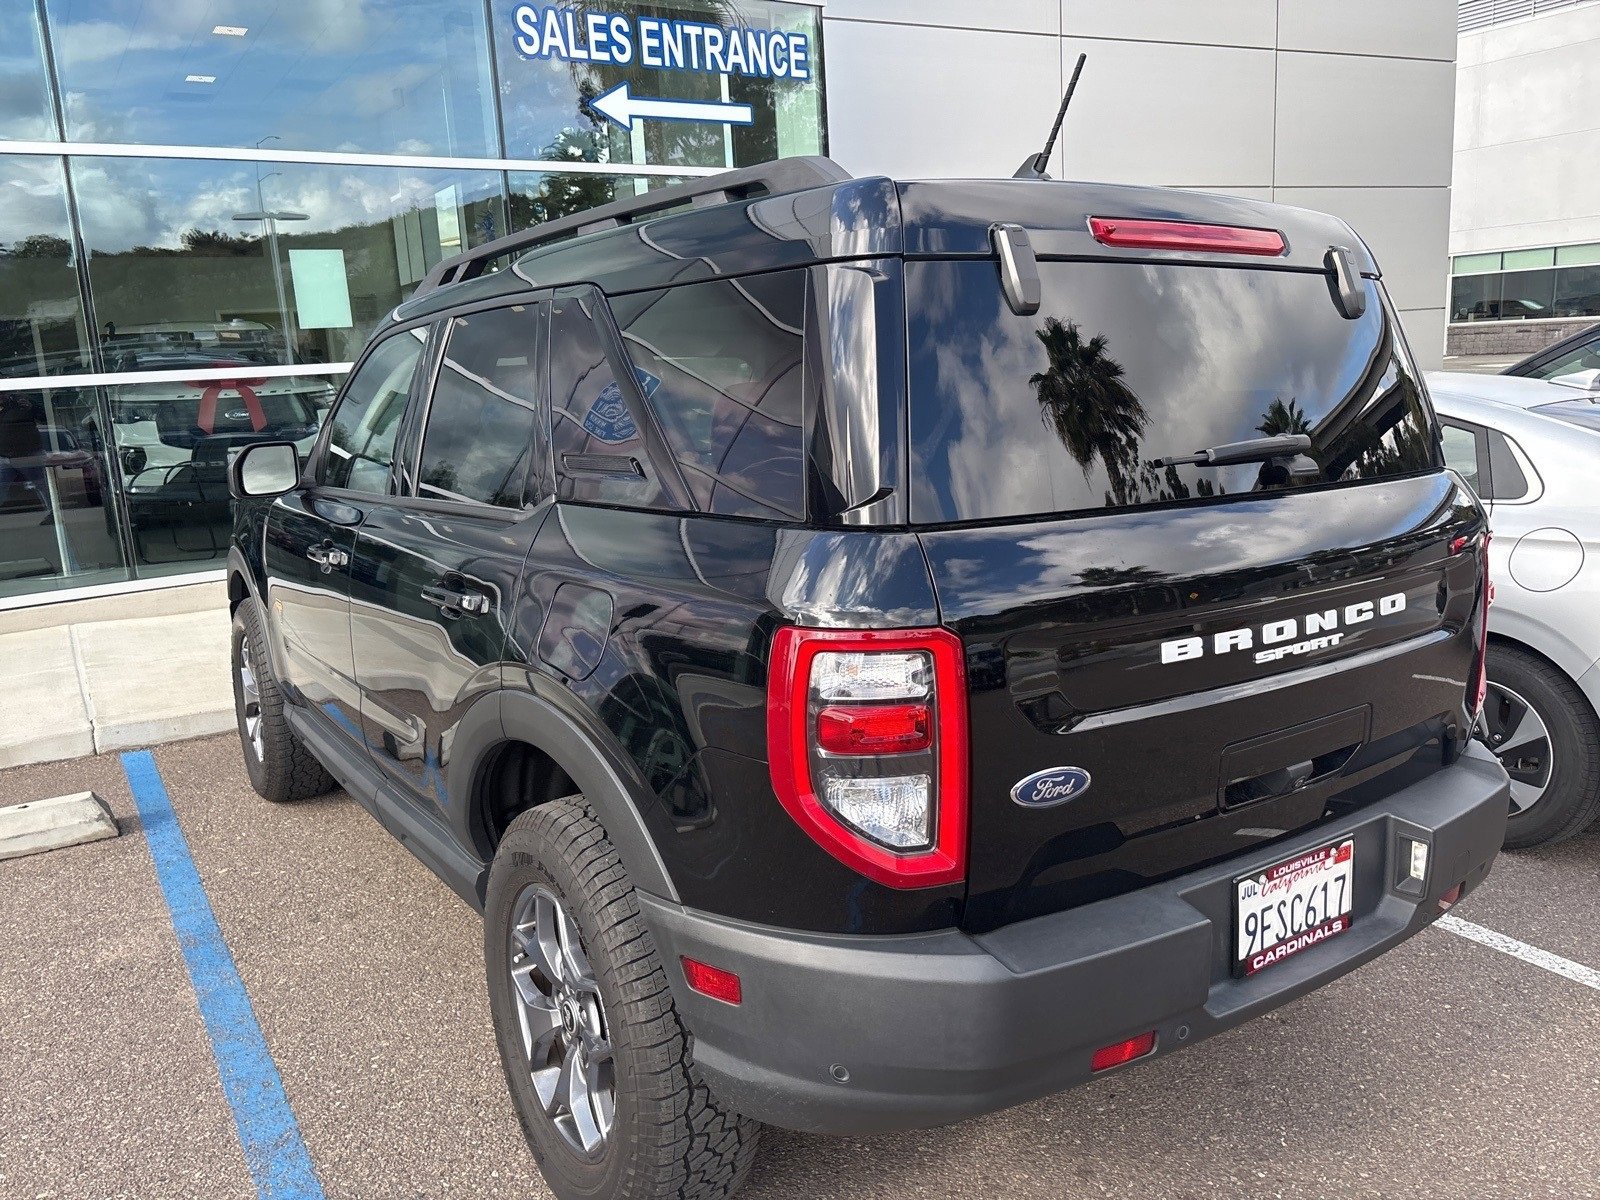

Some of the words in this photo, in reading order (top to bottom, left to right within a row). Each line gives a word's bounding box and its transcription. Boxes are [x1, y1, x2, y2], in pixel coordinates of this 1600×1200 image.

[514, 4, 633, 64] SALES
[639, 19, 809, 79] ENTRANCE
[1160, 592, 1406, 664] BRONCO
[1254, 632, 1344, 664] SPORT
[1031, 775, 1076, 801] Ford
[1261, 860, 1334, 898] California
[1273, 851, 1326, 879] LOUISVILLE
[1241, 884, 1258, 901] JUL
[1244, 873, 1346, 960] 9FSC617
[1252, 920, 1343, 970] CARDINALS
